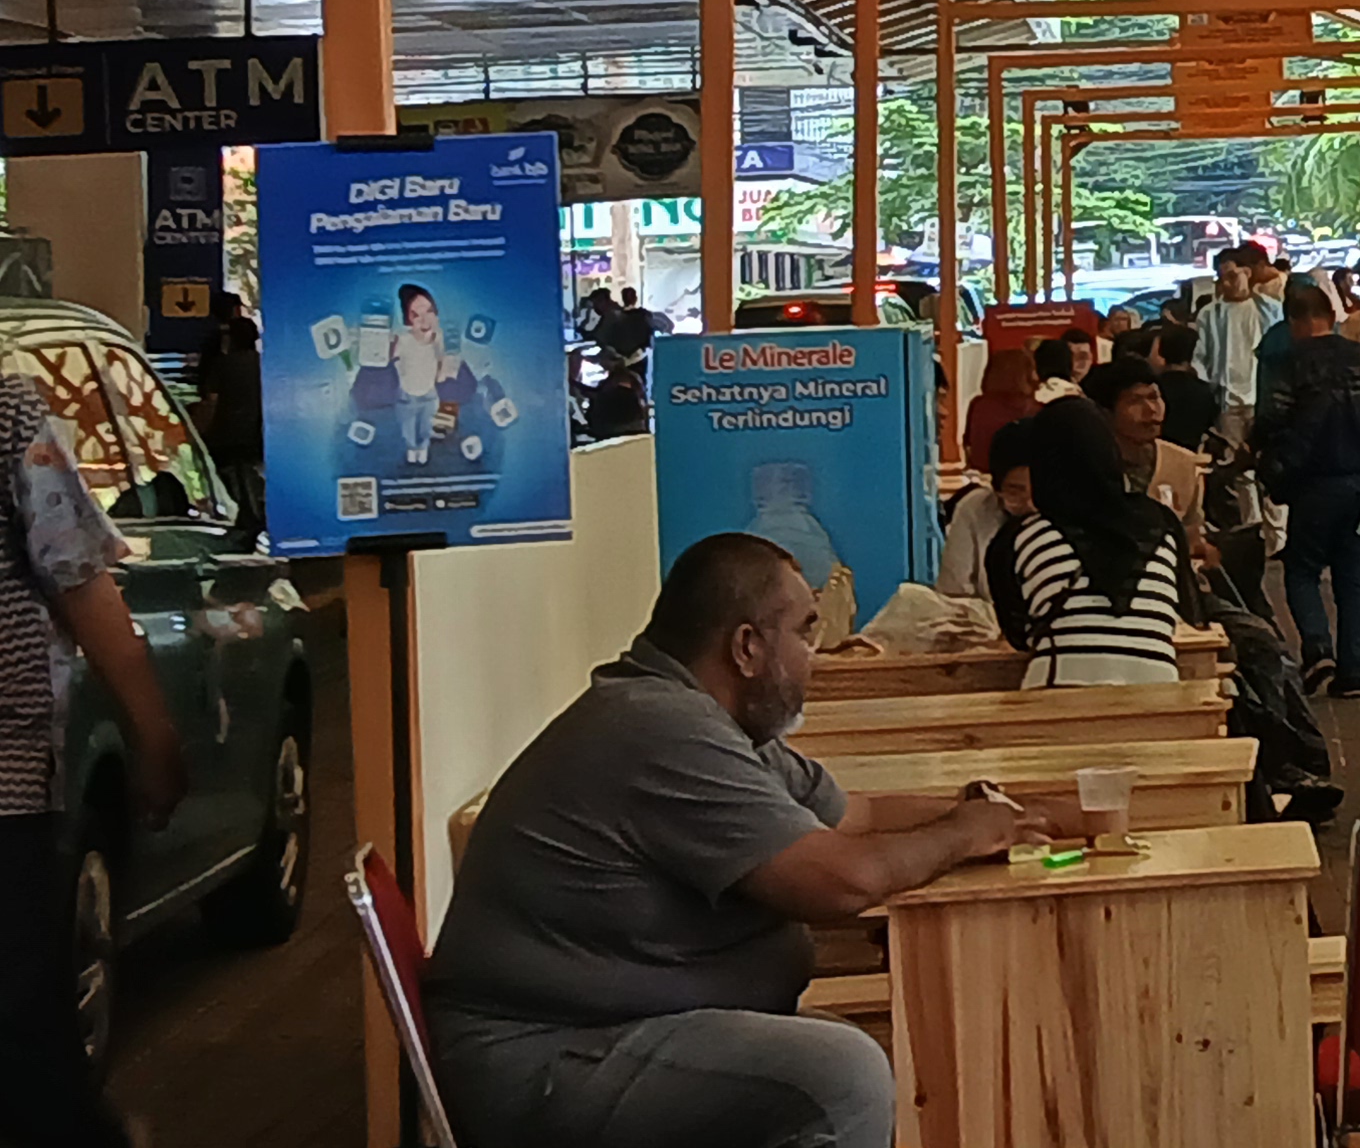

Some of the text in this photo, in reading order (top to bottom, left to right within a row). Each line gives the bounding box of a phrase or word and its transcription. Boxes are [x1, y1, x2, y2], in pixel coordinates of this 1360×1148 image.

[126, 57, 305, 112] ATM
[125, 109, 238, 134] CENTER
[403, 175, 461, 198] Baru
[154, 208, 221, 230] ATM
[309, 198, 503, 234] Pengalaman Baru
[703, 341, 856, 373] Le Minerale
[671, 377, 888, 405] Sehatnya Mineral
[708, 406, 852, 431] Terlindungi
